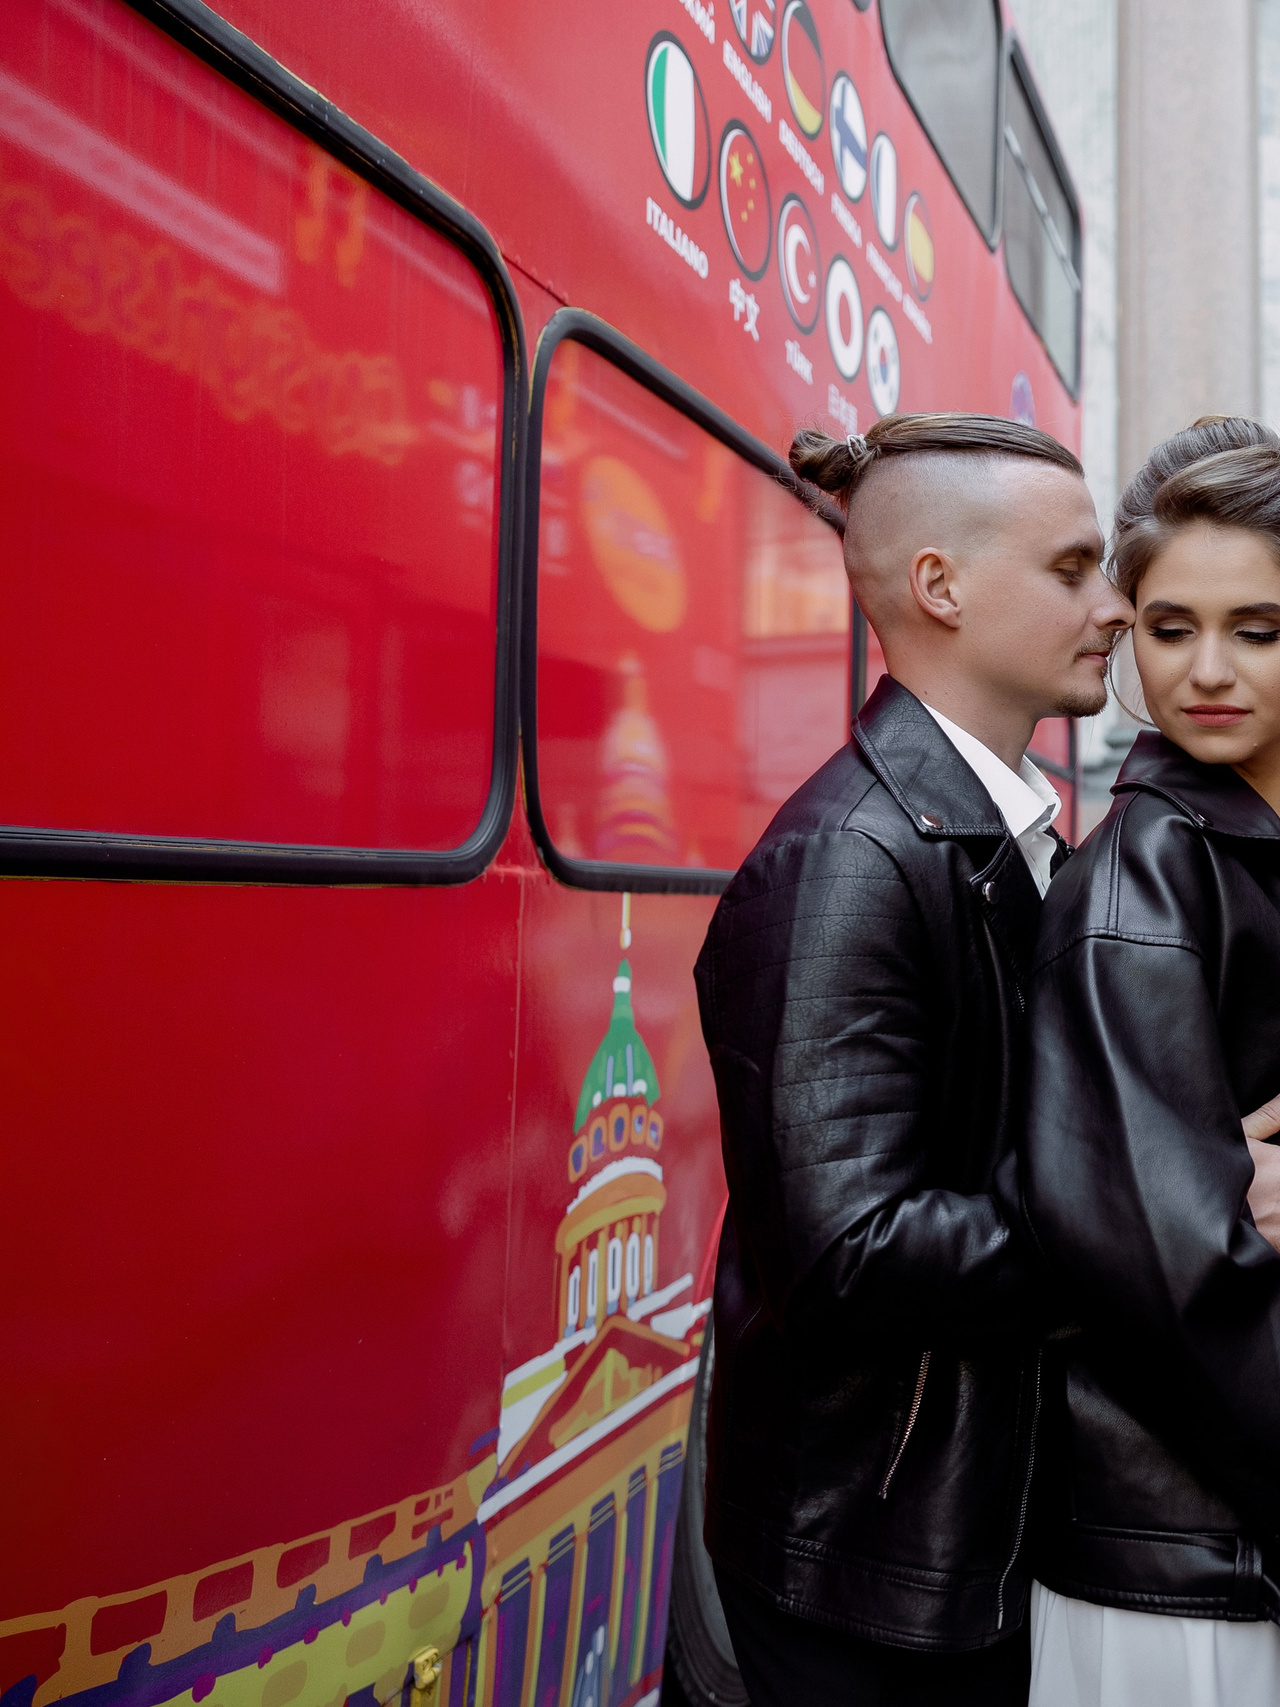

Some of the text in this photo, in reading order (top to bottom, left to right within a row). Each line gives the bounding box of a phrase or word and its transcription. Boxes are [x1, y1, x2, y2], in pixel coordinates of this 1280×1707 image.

[723, 39, 772, 123] ENGLISH
[646, 196, 709, 279] ITALIANO
[729, 278, 760, 341] 中文
